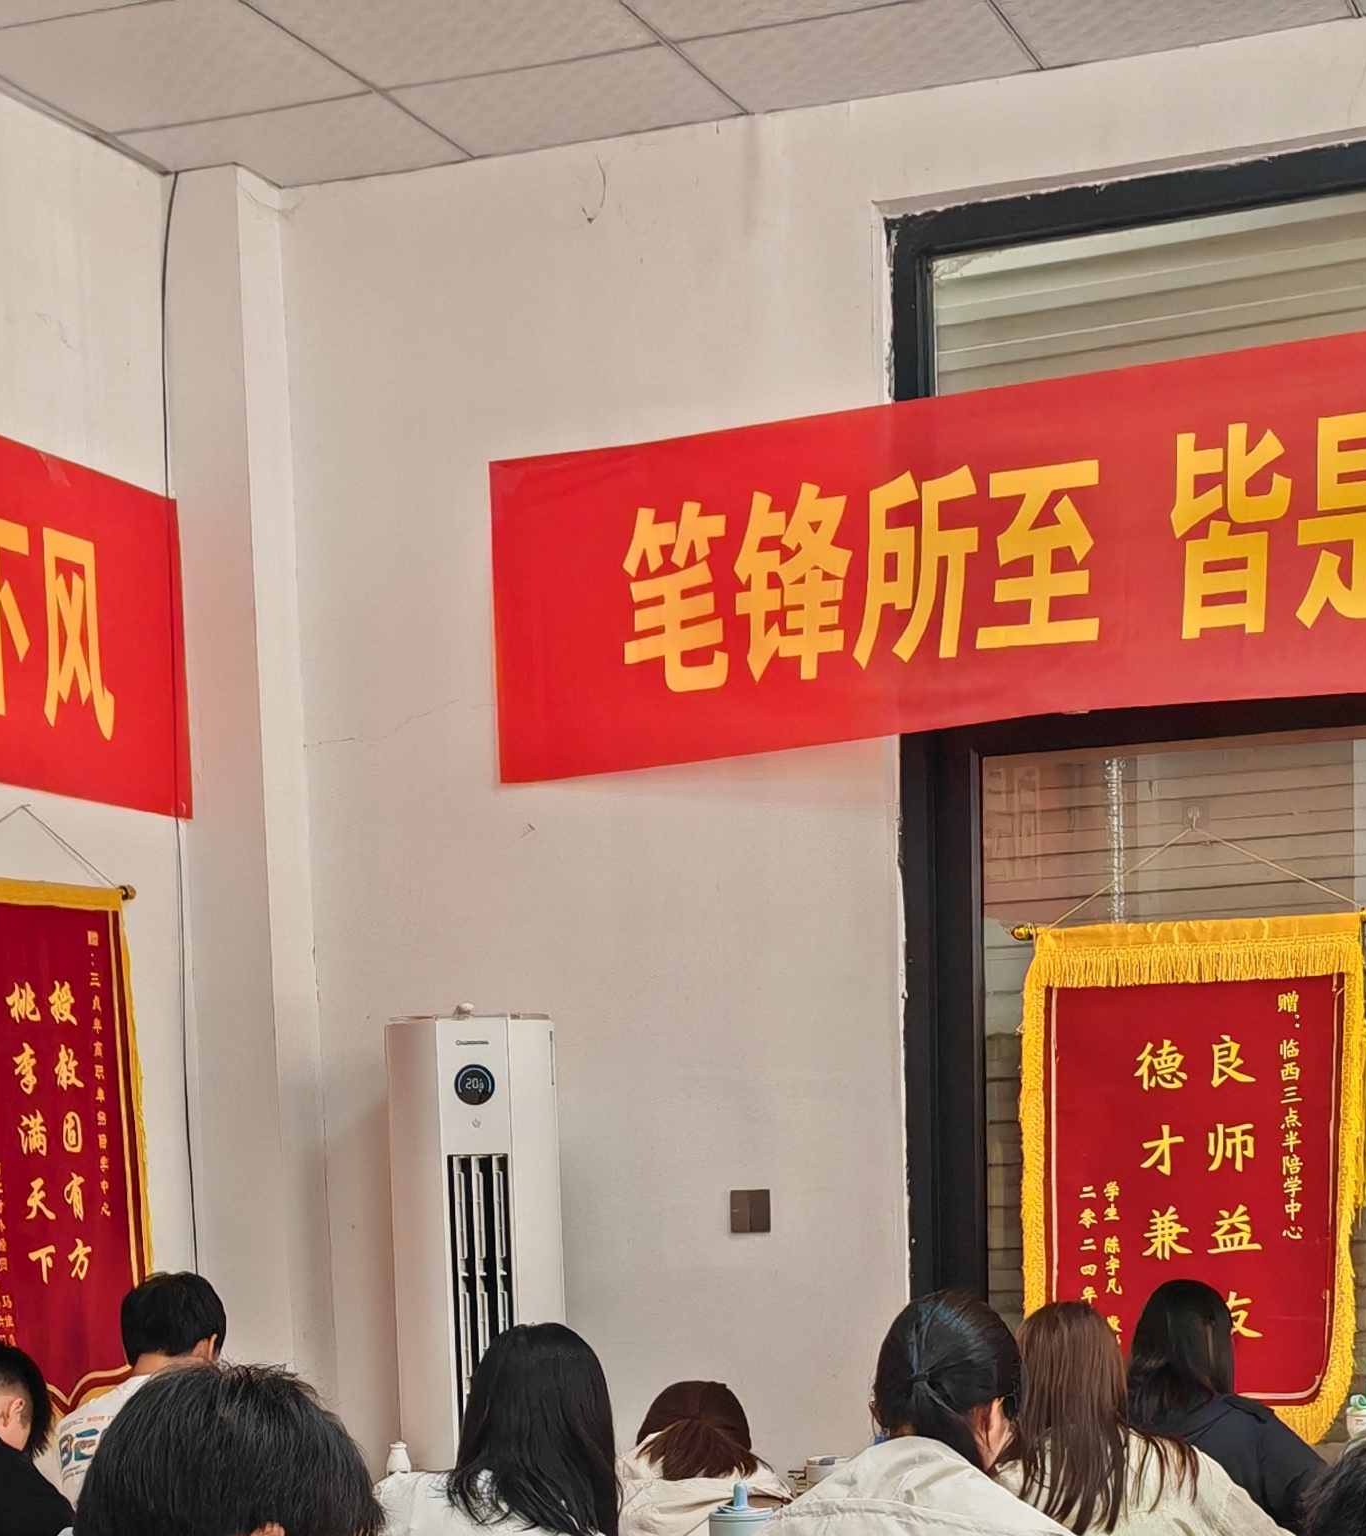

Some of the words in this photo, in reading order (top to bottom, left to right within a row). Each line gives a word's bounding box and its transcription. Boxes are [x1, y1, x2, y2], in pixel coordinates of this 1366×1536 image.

[622, 458, 1100, 692] 笔锋所至
[5, 980, 56, 1285] 桃李满天下
[1206, 1034, 1263, 1339] 良师益友
